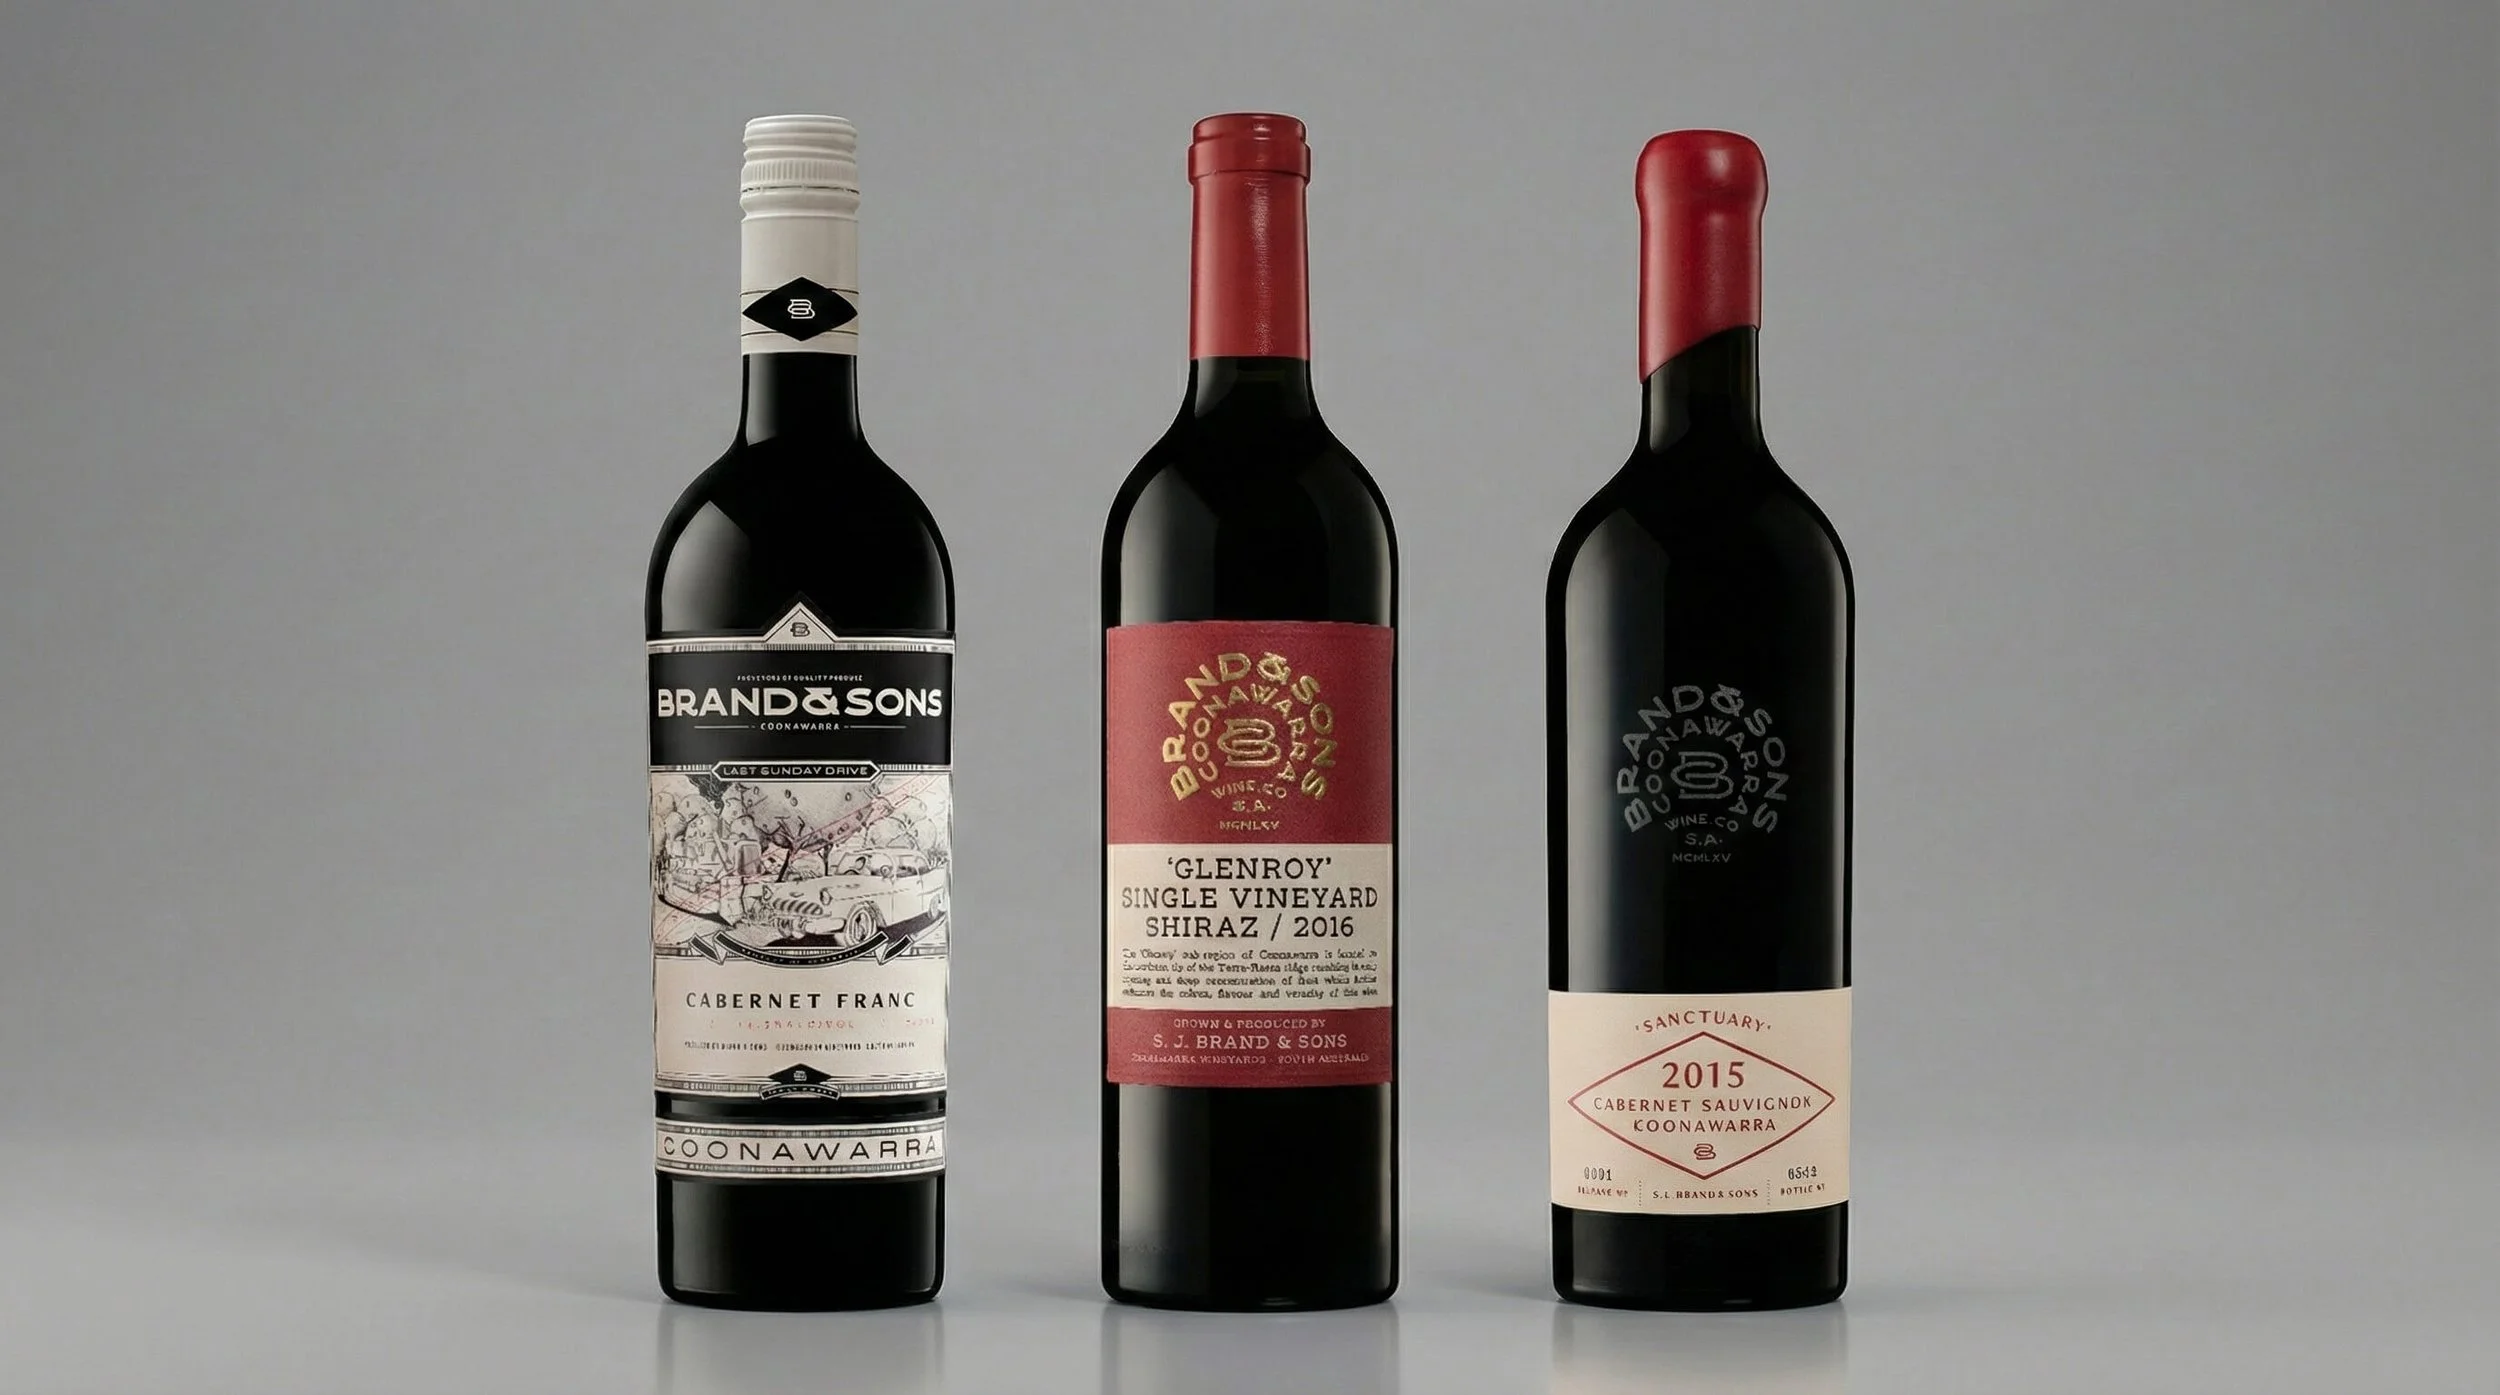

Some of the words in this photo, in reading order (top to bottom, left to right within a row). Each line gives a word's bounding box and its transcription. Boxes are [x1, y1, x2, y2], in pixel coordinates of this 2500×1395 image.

[825, 766, 869, 776] DRIVE
[1645, 715, 1760, 816] COONAWARRA
[1672, 853, 1731, 863] MCMLXV
[1122, 887, 1218, 909] SINGLE
[1229, 887, 1378, 909] VINEYARD
[1145, 916, 1258, 938] SHIRAZ
[1270, 913, 1282, 941] /
[1294, 916, 1355, 938] 2016
[686, 992, 821, 1009] CABERNET
[837, 992, 915, 1009] FRANC
[1196, 1035, 1270, 1050] BRAND
[1277, 1034, 1292, 1049] &
[1298, 1033, 1347, 1049] SONS
[1662, 1061, 1745, 1089] 2015
[1594, 1098, 1691, 1112] CABERNET
[663, 1136, 939, 1161] COONAWARRA
